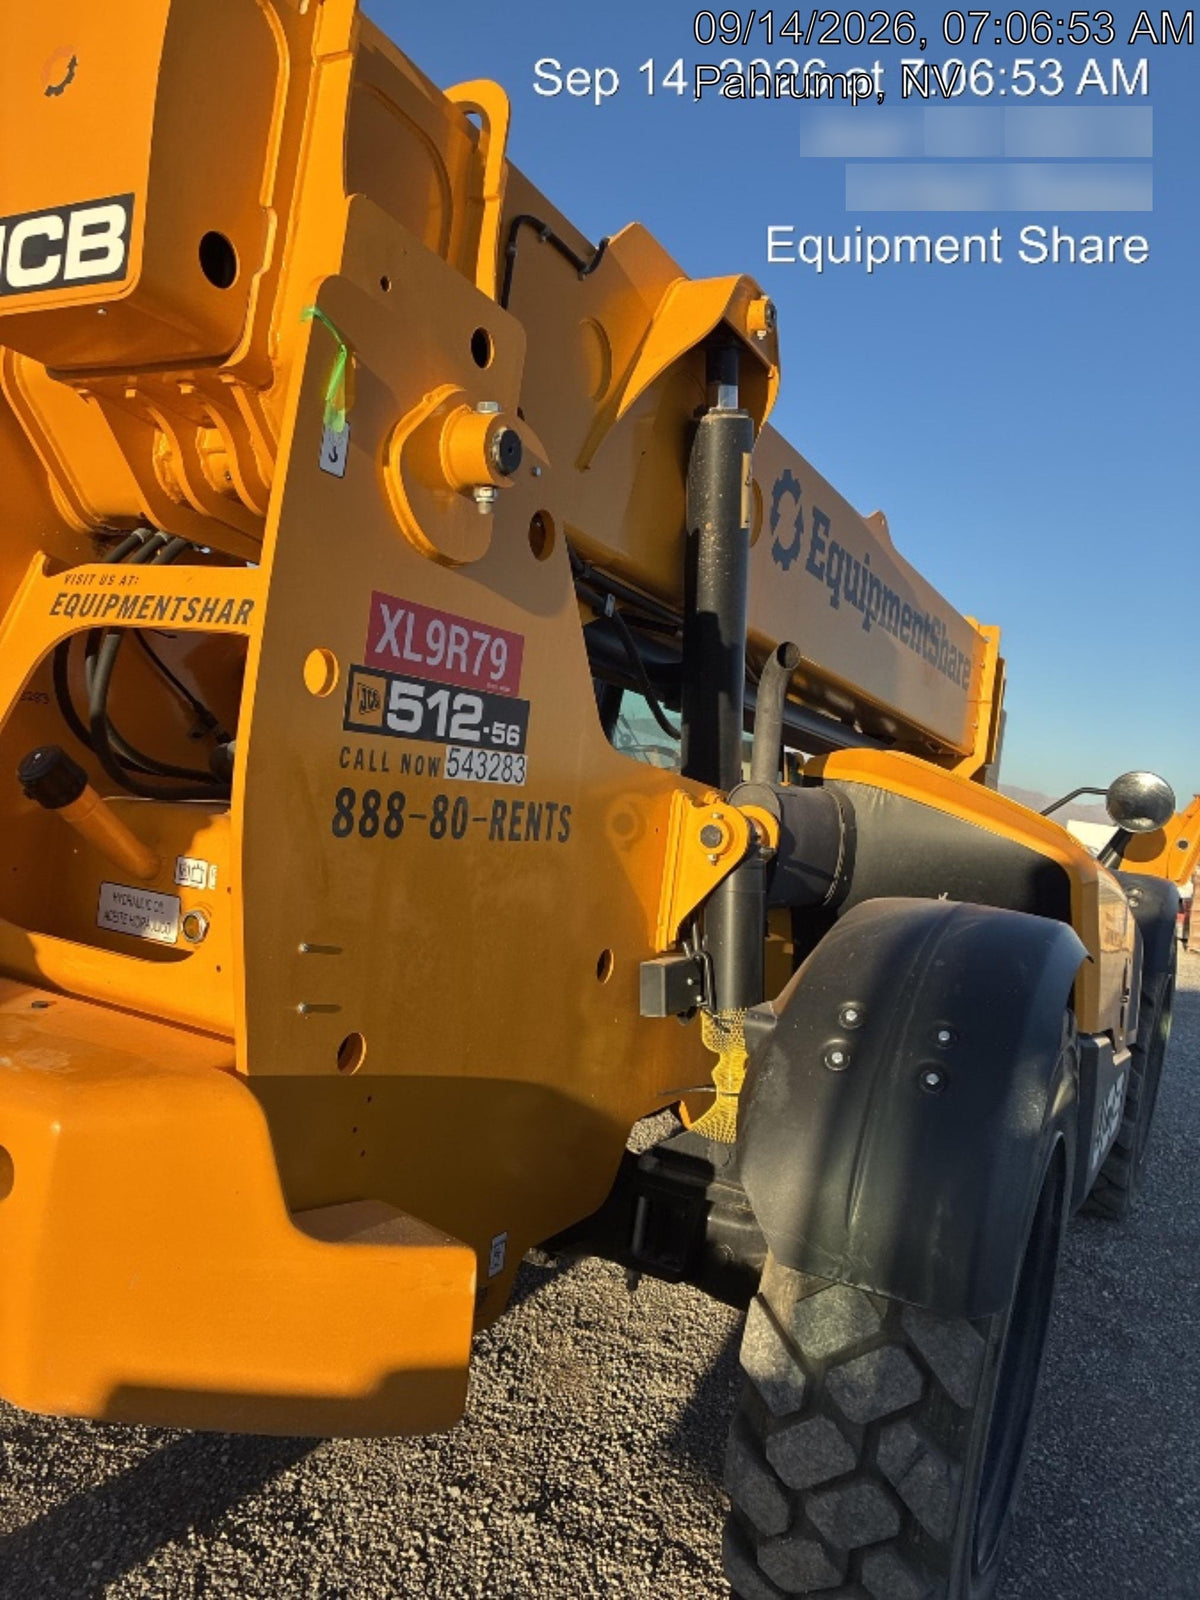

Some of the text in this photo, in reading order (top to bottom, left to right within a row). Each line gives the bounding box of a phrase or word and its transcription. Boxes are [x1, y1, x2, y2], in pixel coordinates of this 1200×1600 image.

[64, 573, 140, 586] VISIT US AT:
[805, 505, 972, 691] EquipmentShare
[375, 602, 508, 681] XL9R79
[339, 746, 441, 778] CALL NOW
[446, 747, 526, 784] 543283
[332, 787, 573, 843] 888-80-RENTS
